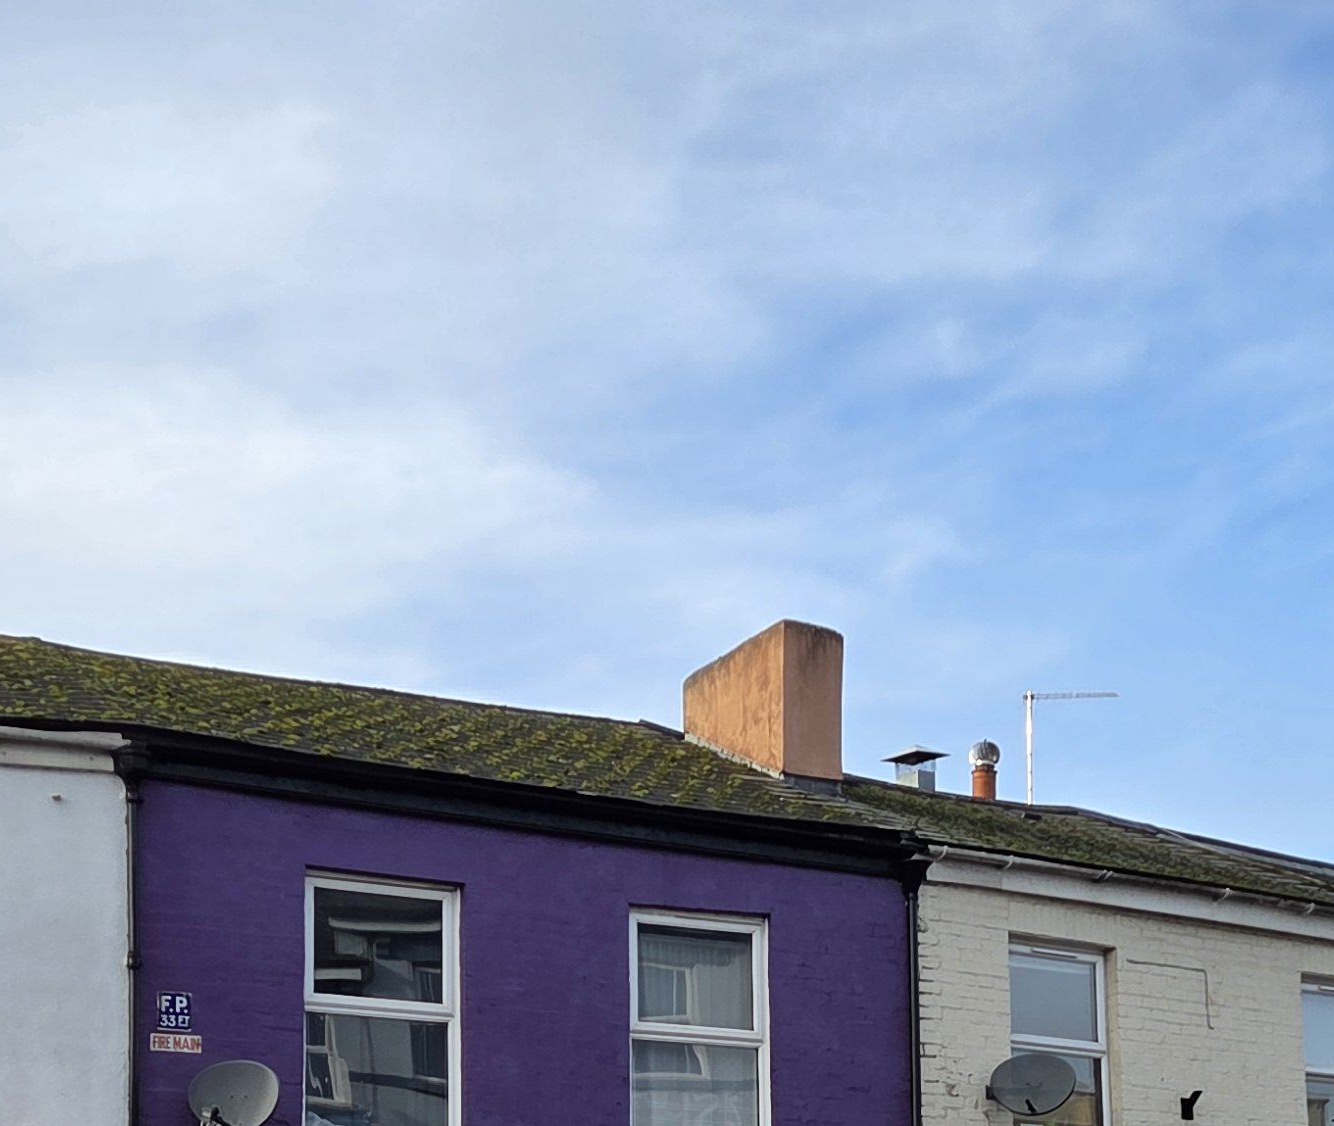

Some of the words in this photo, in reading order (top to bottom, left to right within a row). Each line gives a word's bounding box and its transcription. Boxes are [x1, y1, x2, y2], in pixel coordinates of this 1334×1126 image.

[161, 995, 188, 1014] F.P.
[153, 1036, 171, 1049] FIRE
[173, 1037, 200, 1051] MAIN
